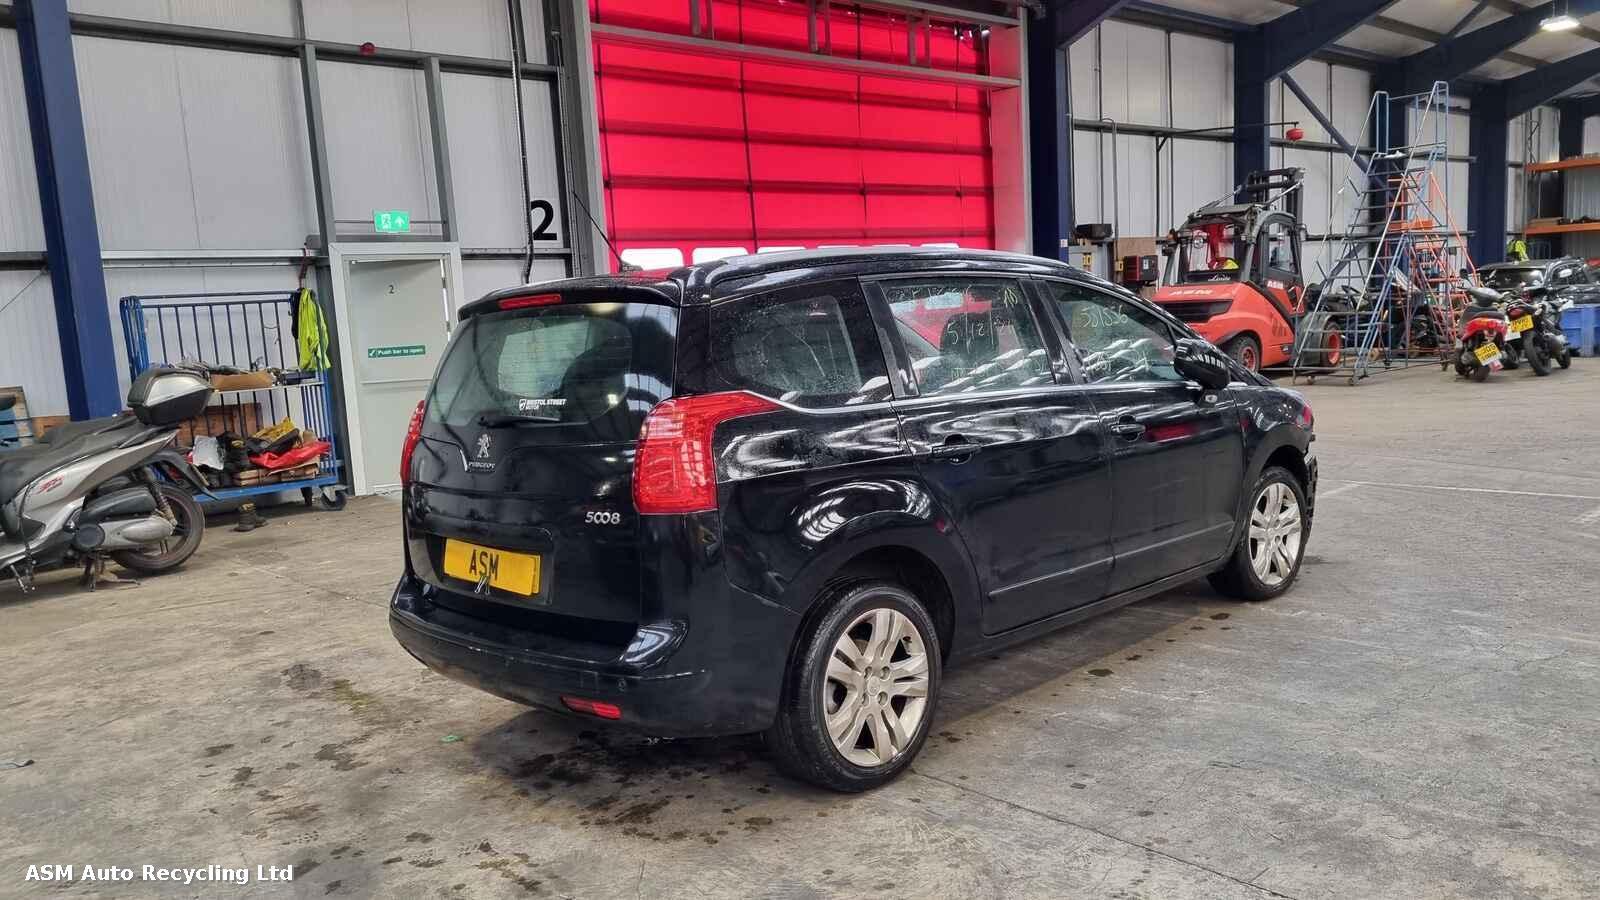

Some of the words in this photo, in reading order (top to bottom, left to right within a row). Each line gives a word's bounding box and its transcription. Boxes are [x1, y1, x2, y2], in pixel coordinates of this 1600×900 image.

[530, 199, 558, 241] 2
[388, 284, 395, 294] 2
[584, 511, 621, 525] 5008
[469, 549, 500, 581] ASM
